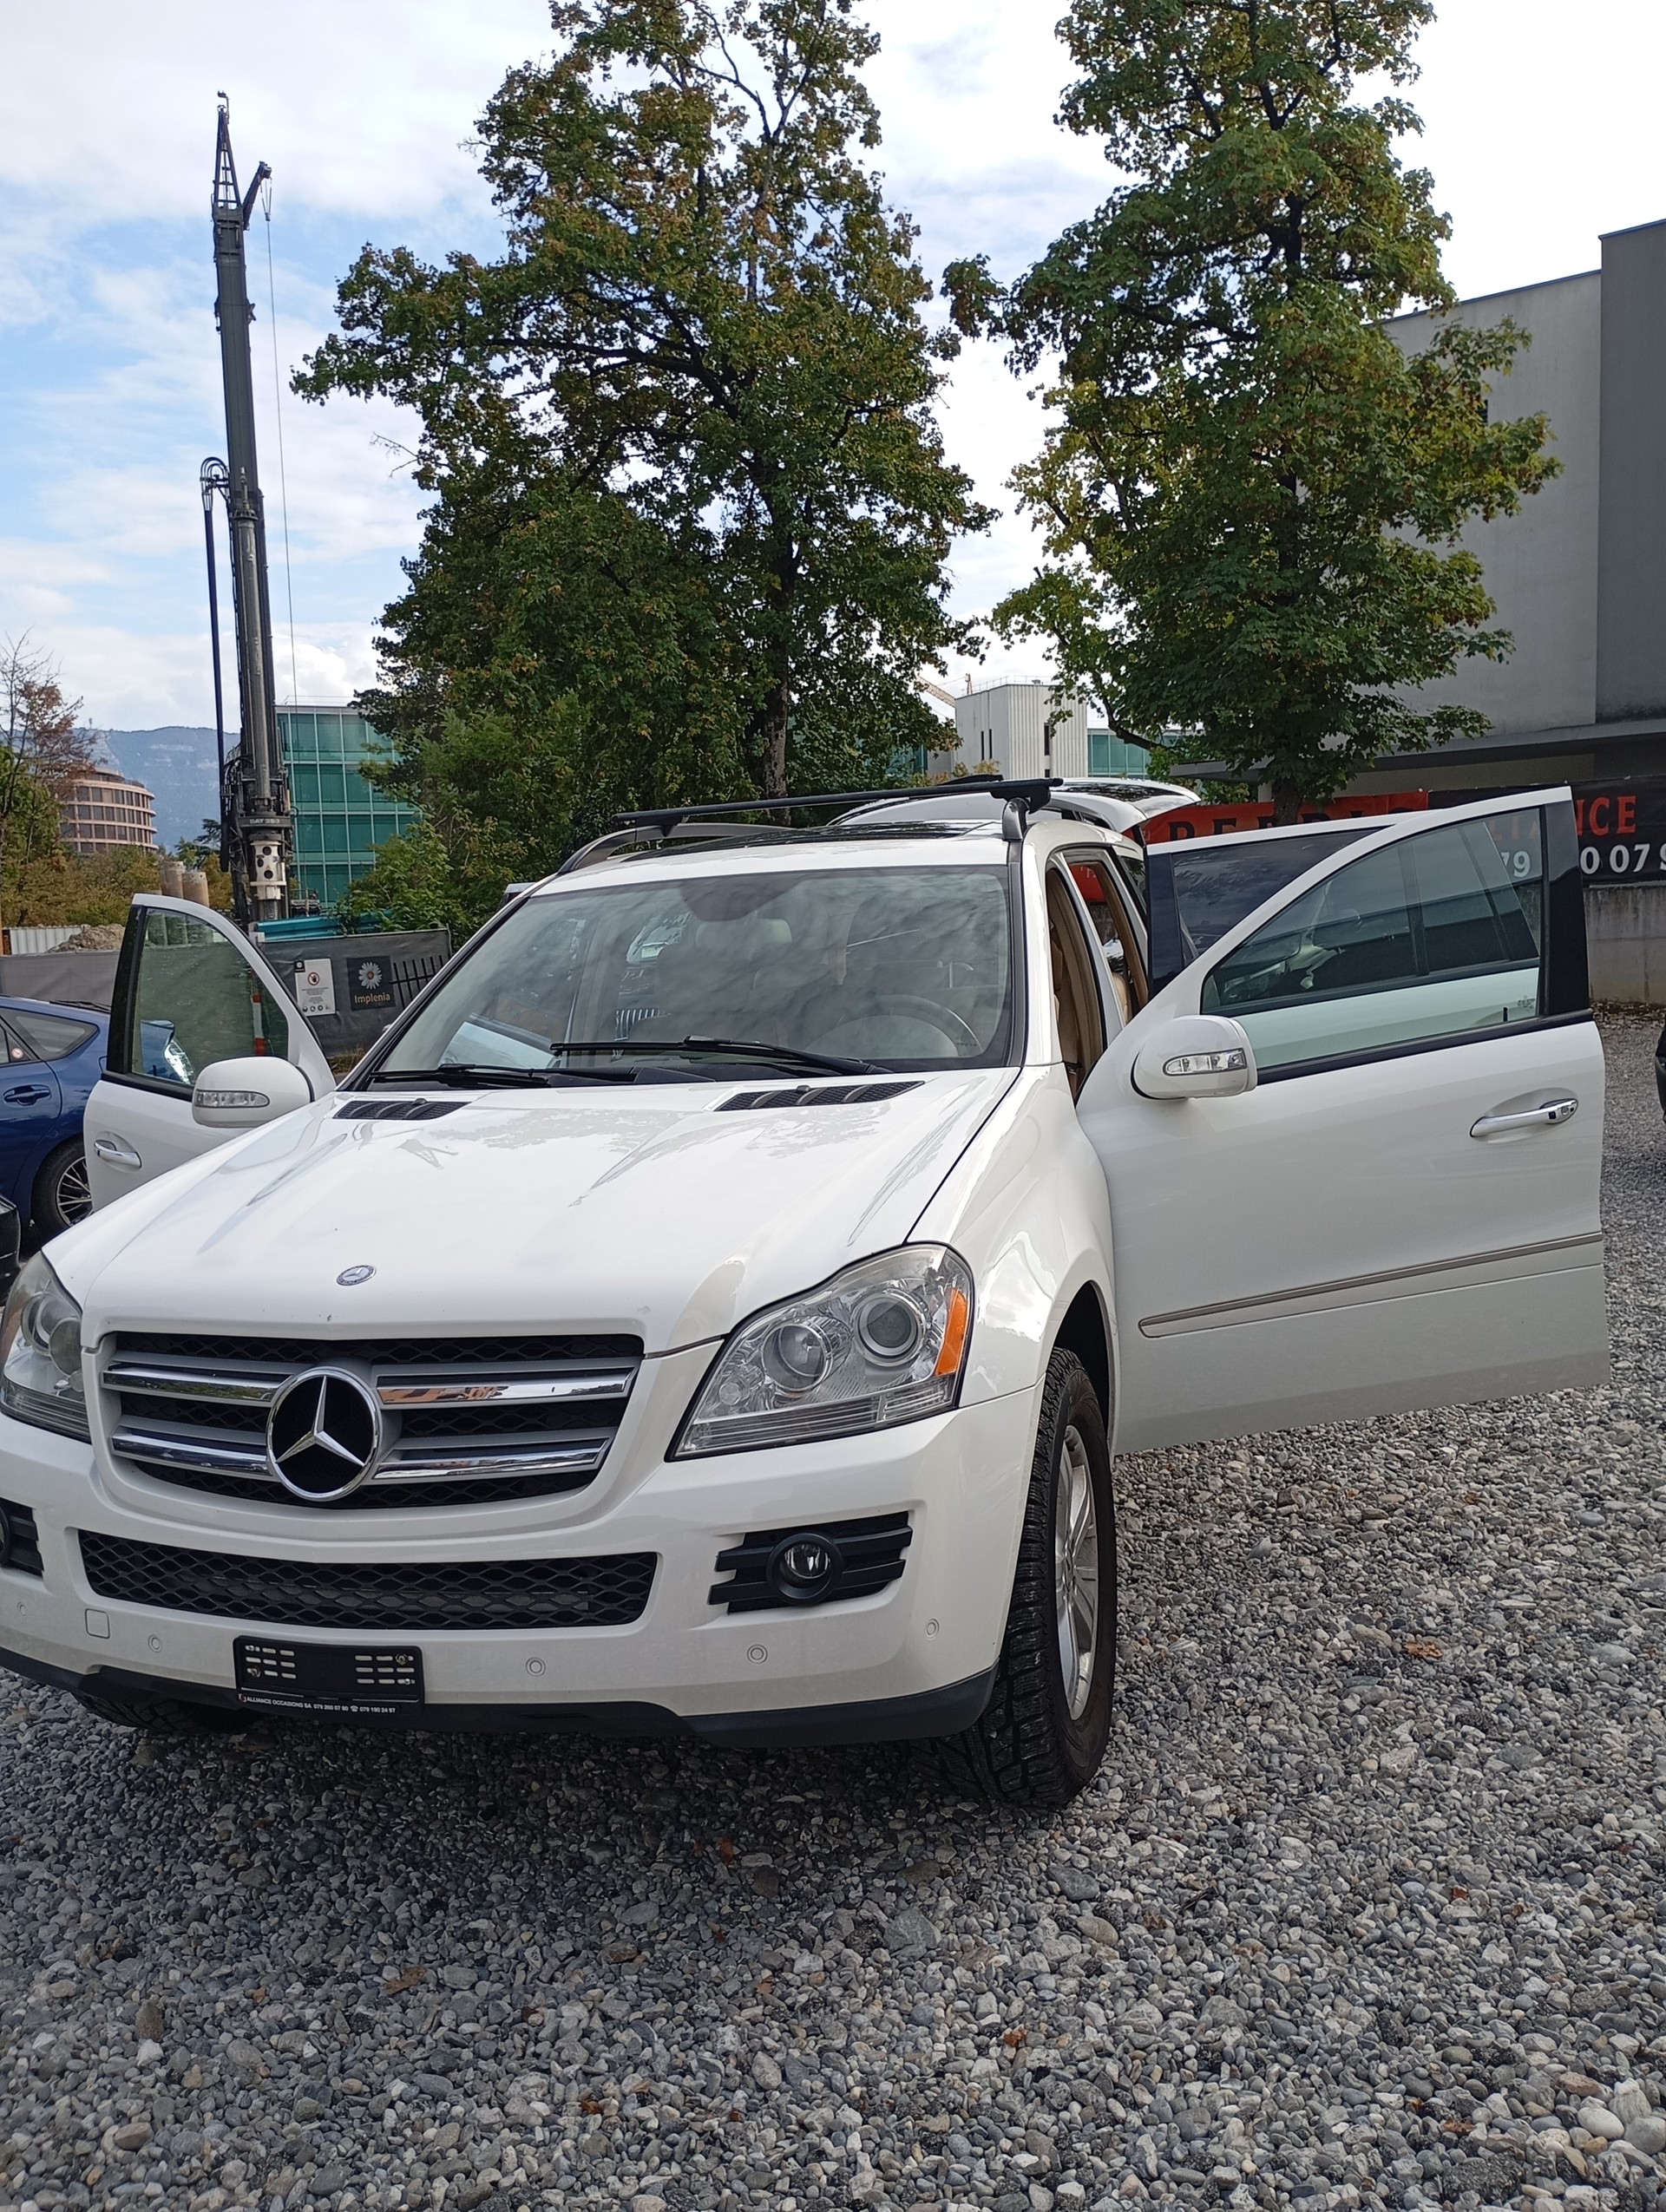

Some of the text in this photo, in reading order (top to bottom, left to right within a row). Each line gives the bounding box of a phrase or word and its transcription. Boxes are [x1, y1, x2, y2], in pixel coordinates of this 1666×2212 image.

[1610, 843, 1650, 874] 07
[354, 991, 390, 1005] Implenia
[247, 1696, 272, 1705] ALLIANCE
[272, 1699, 304, 1708] OCCASIONS
